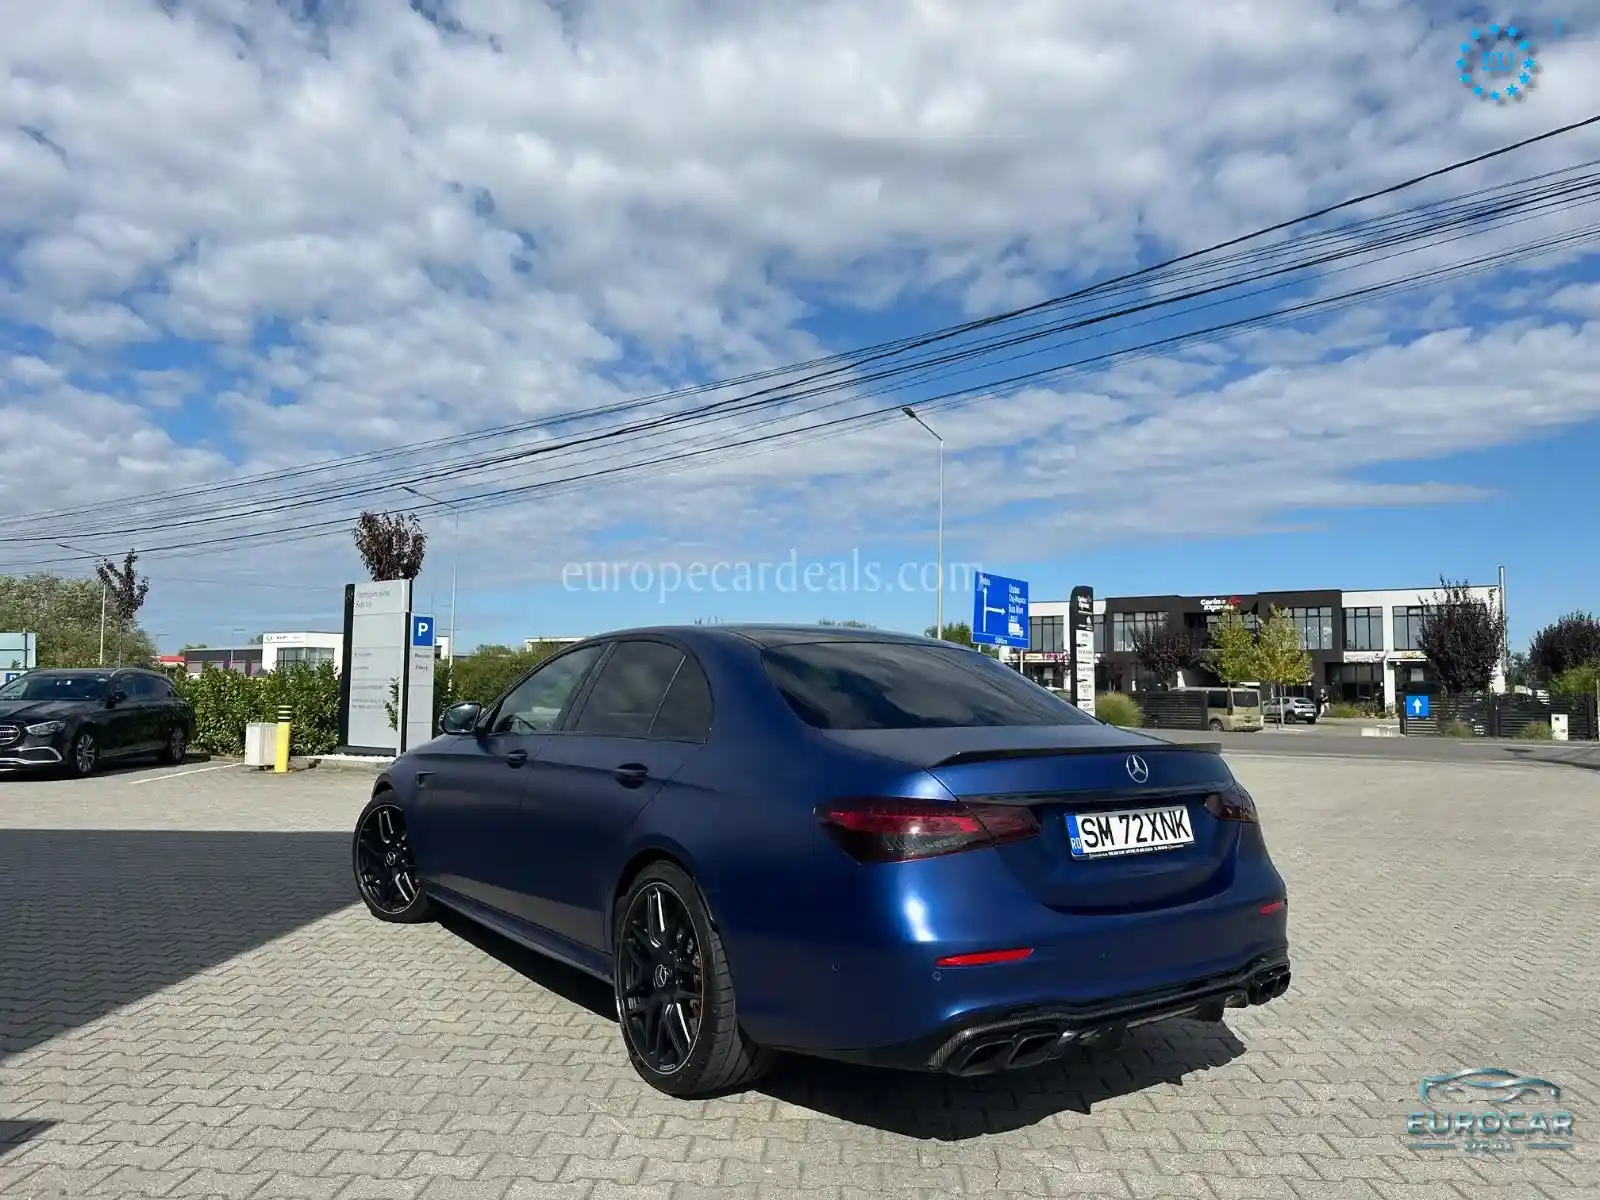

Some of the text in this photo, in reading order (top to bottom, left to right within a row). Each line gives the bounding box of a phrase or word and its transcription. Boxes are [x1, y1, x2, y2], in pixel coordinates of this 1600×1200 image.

[418, 622, 429, 637] P
[1081, 809, 1190, 848] SM 72XNK
